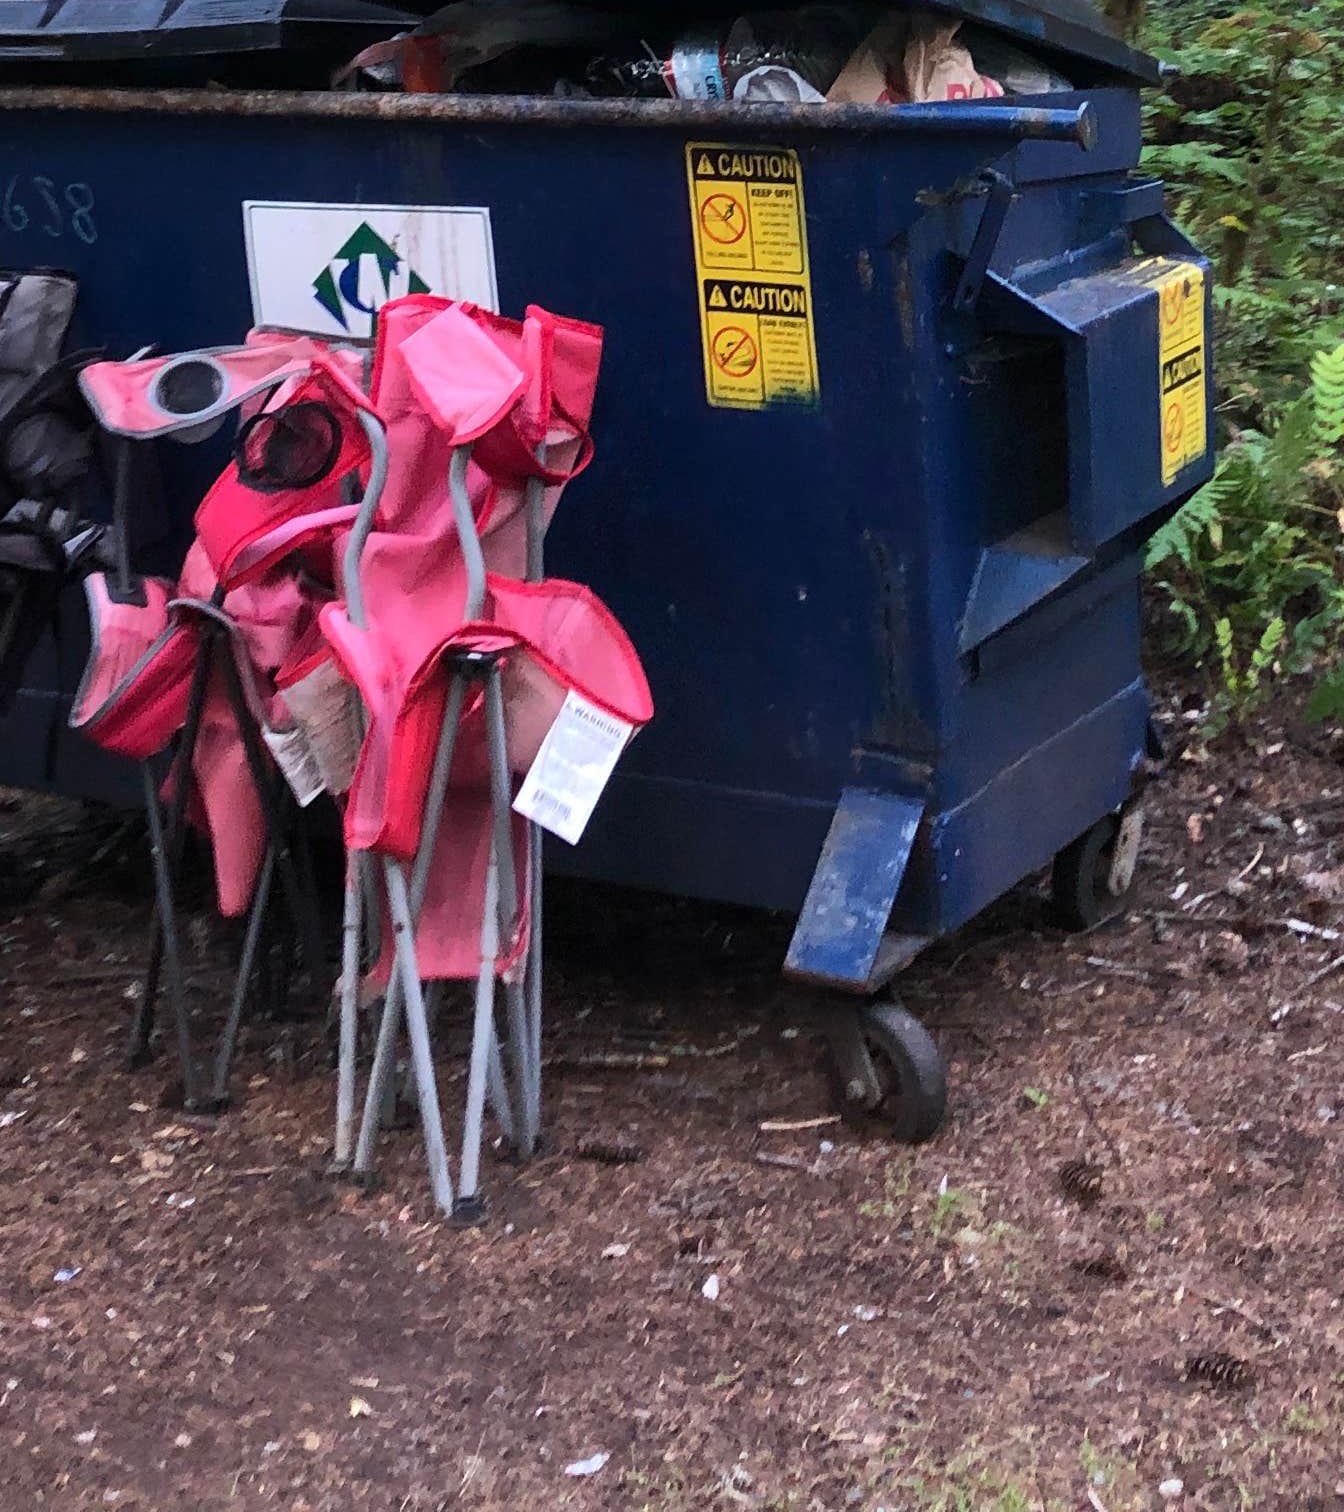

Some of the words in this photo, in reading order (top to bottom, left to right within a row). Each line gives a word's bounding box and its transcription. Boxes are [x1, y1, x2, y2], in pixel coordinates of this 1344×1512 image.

[717, 153, 795, 179] CAUTION
[751, 188, 771, 198] KEEP
[729, 285, 806, 314] CAUTION
